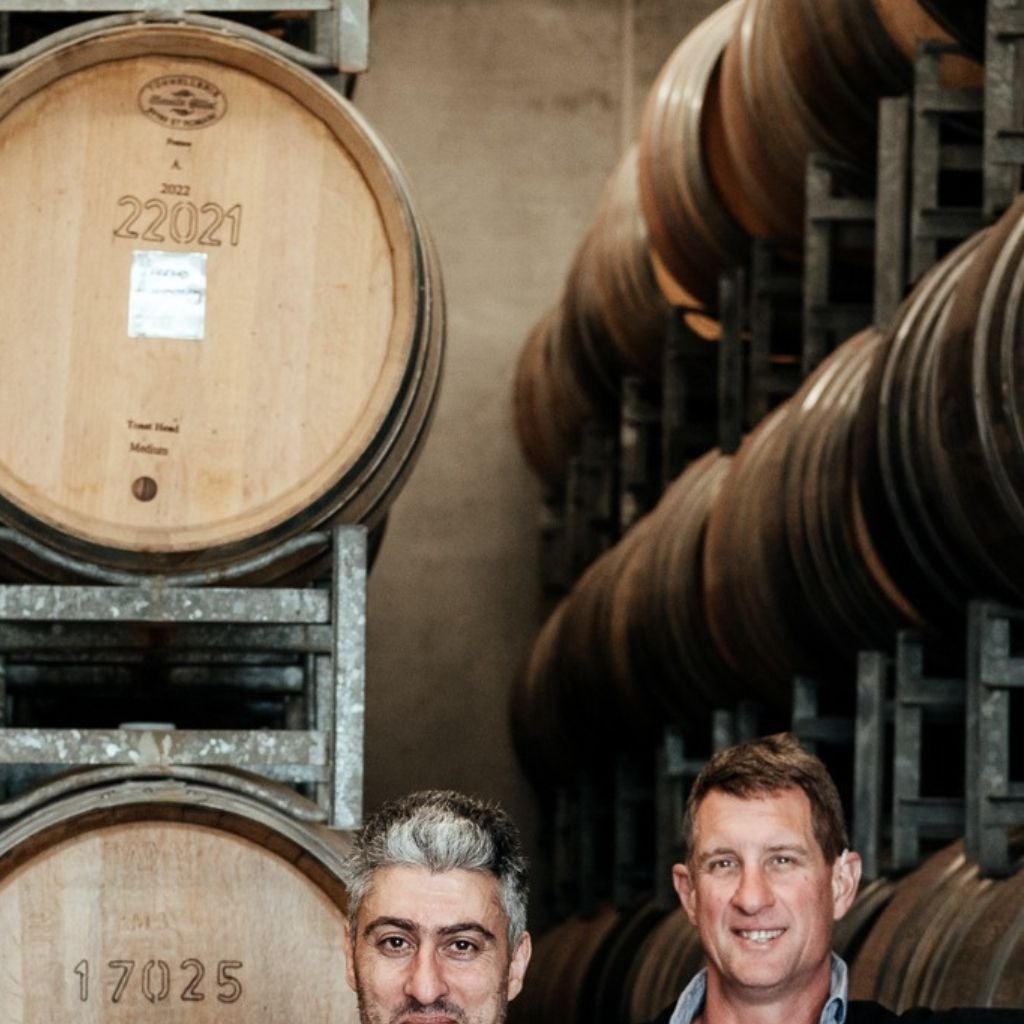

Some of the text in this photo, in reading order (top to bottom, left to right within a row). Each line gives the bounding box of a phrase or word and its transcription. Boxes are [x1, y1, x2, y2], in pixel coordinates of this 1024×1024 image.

[160, 183, 191, 196] 2022
[113, 195, 243, 247] 22021
[73, 957, 244, 1004] 17025
